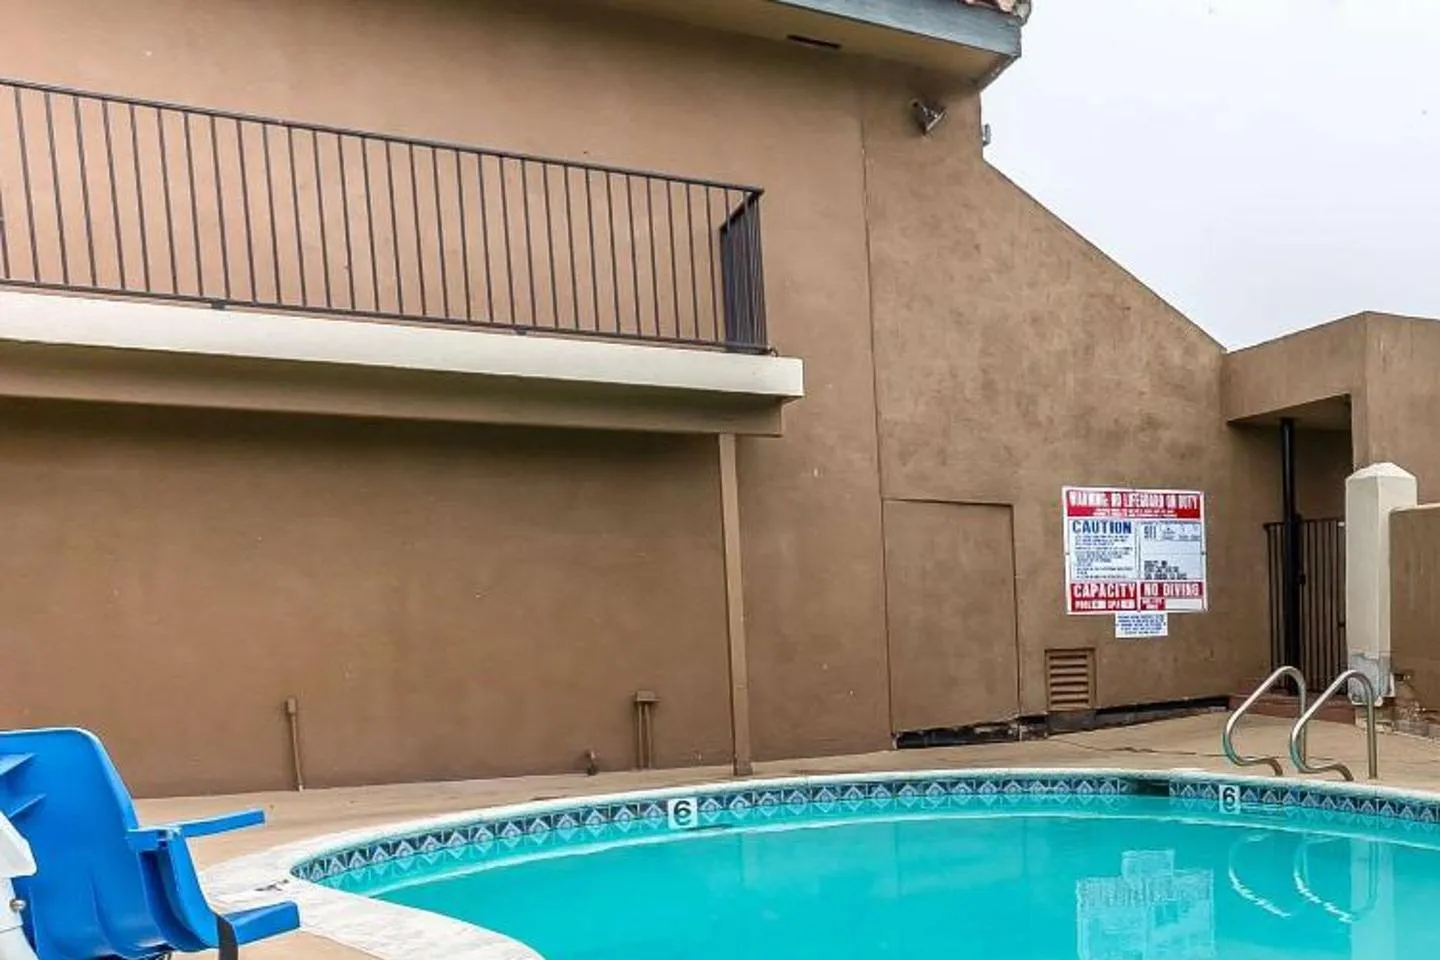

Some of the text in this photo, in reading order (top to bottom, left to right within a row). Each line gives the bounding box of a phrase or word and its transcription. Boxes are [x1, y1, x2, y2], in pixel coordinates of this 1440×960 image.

[1072, 520, 1132, 534] CAUTION
[1073, 583, 1135, 598] CAPACITY
[1143, 583, 1200, 597] NO DIVING
[673, 800, 692, 826] 6
